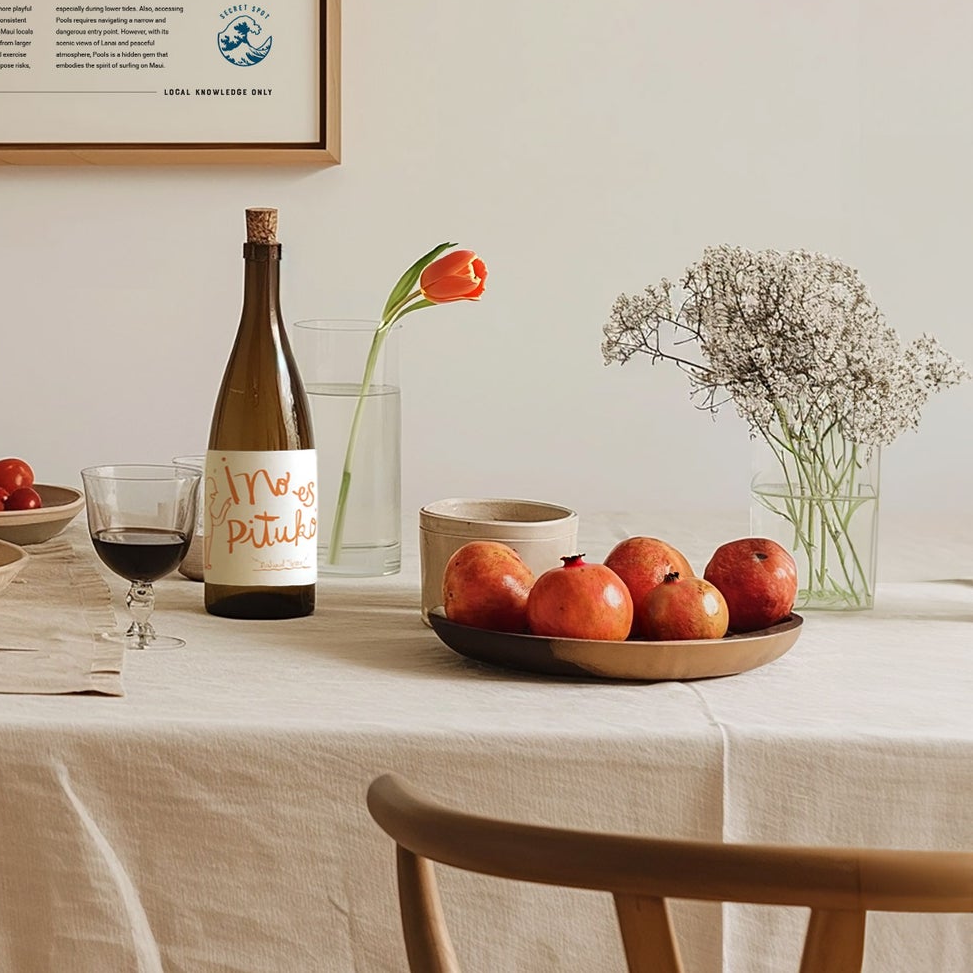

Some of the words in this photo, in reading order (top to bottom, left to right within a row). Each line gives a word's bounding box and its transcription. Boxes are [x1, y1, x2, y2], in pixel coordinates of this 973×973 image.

[12, 5, 32, 14] playful
[56, 5, 84, 14] especially
[85, 5, 104, 14] during
[139, 5, 153, 13] Also,
[154, 5, 184, 14] accessing
[220, 4, 247, 19] SECRET
[252, 6, 270, 19] SPOT
[73, 17, 97, 26] requires
[98, 17, 128, 26] navigating
[56, 28, 86, 37] dangerous
[87, 28, 102, 37] entry
[103, 28, 119, 37] point.
[120, 28, 147, 36] However,
[15, 39, 31, 48] larger
[130, 39, 155, 48] peaceful
[56, 51, 91, 60] atmosphere,
[15, 62, 31, 70] risks,
[96, 62, 110, 71] spirit
[119, 62, 139, 71] surfing
